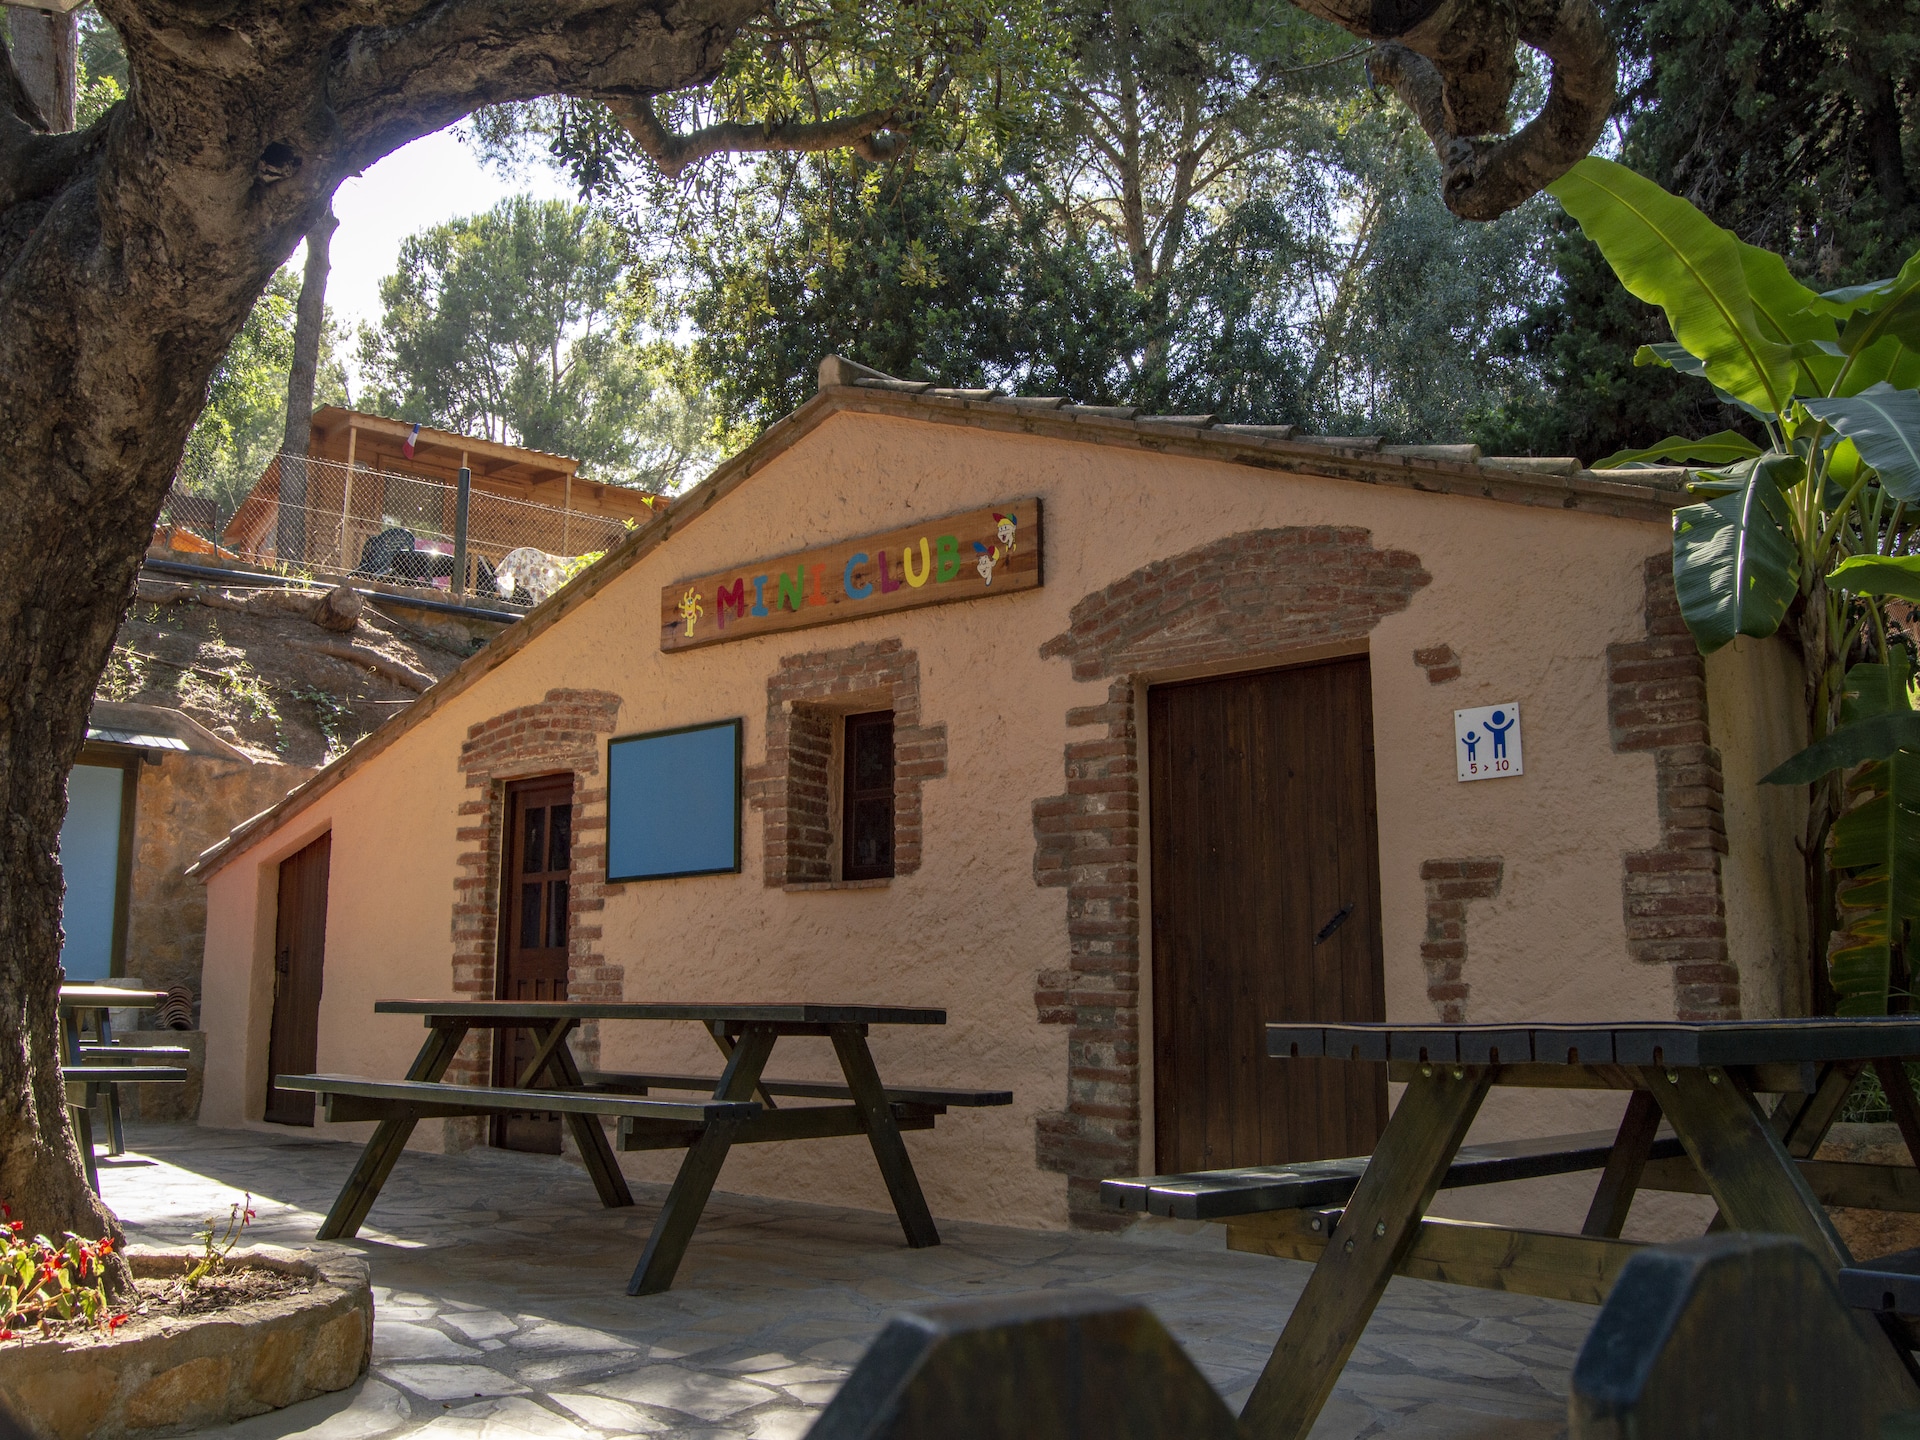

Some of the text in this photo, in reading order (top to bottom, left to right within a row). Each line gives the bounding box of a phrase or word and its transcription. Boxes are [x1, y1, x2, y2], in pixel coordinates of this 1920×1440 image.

[717, 535, 961, 629] MINI CLUB
[1470, 763, 1478, 774] 5
[1495, 760, 1509, 771] 10
